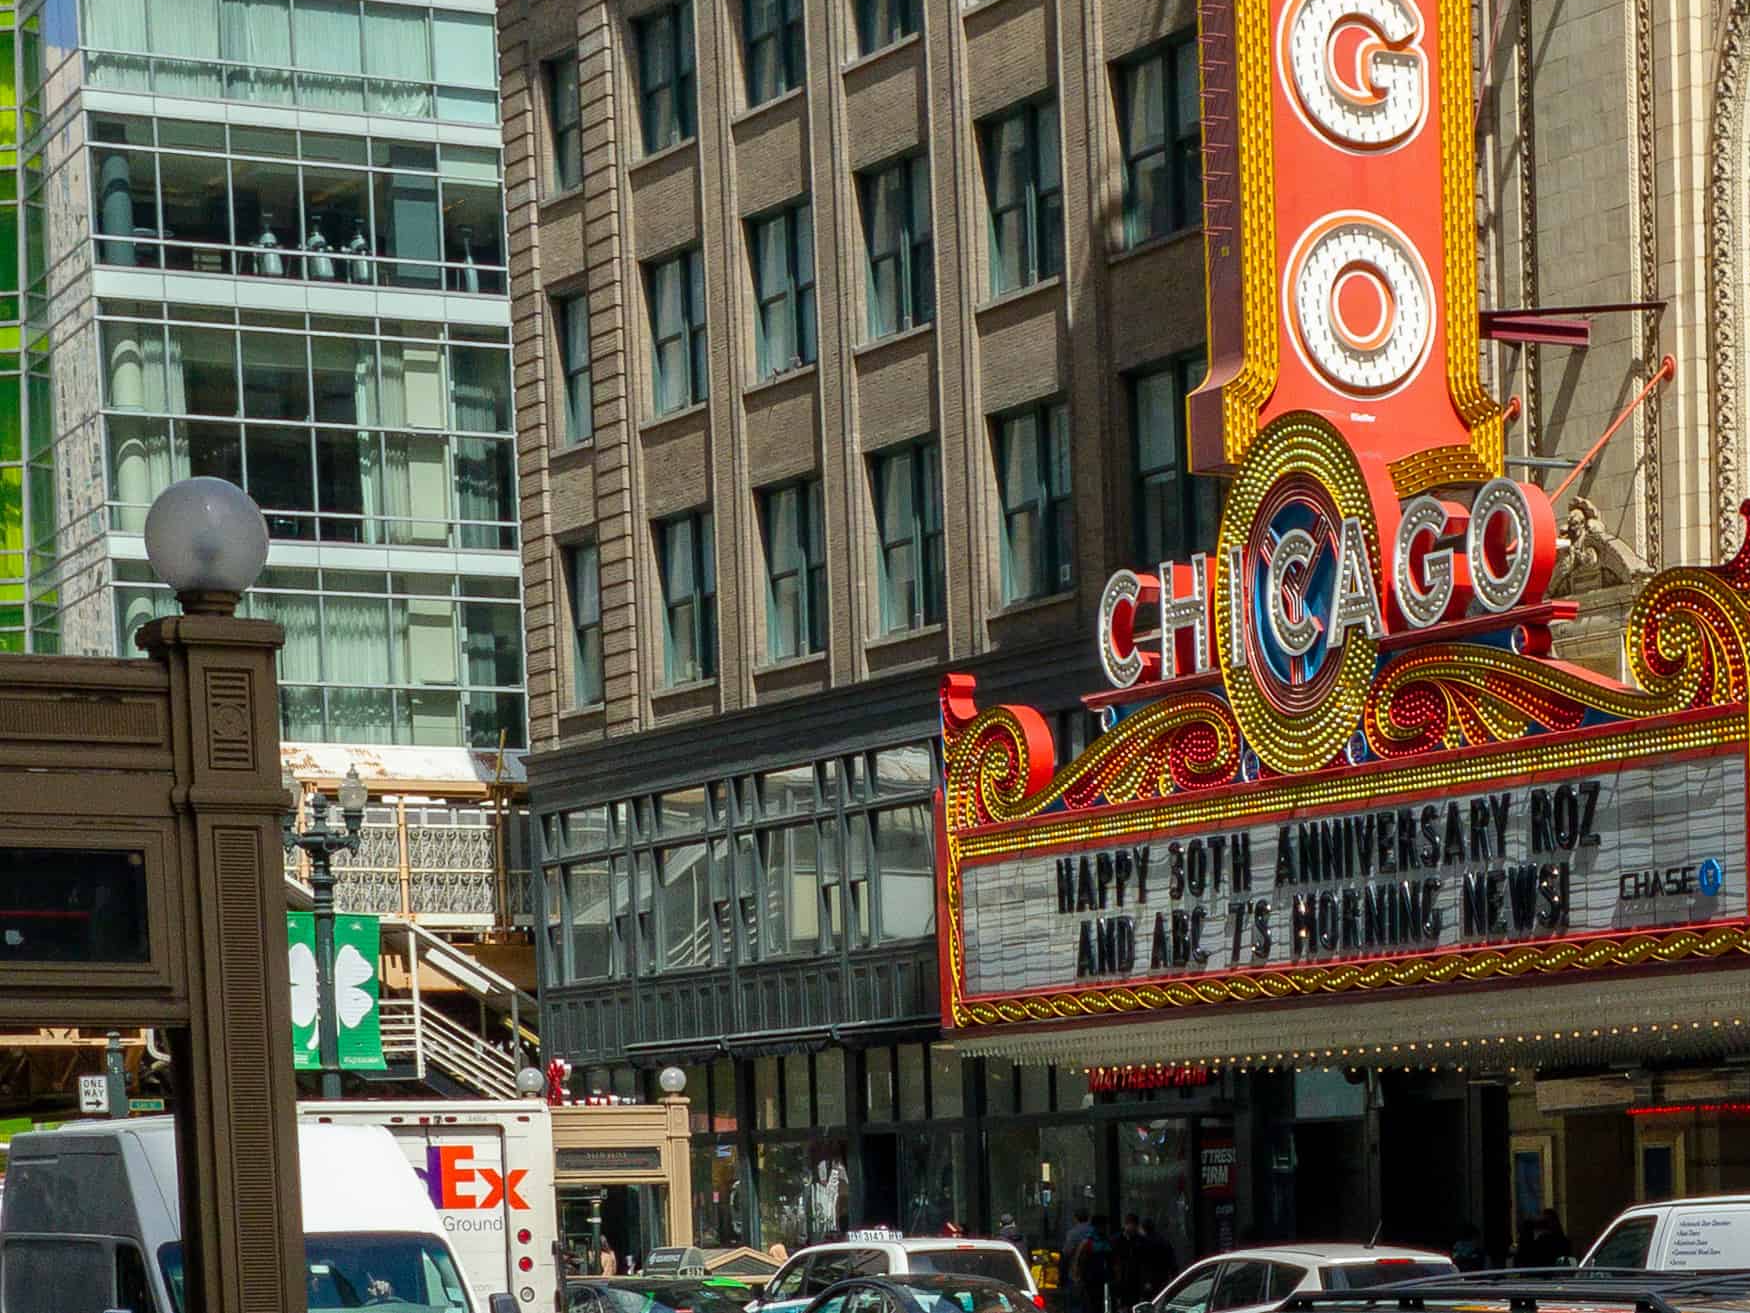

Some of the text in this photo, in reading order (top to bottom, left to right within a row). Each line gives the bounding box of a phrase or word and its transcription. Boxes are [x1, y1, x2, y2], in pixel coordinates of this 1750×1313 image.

[1099, 477, 1534, 689] CHICAGO
[1056, 845, 1150, 914] HAPPY
[1275, 792, 1511, 886] ANNIVERSARY
[1531, 780, 1600, 854] ROZ
[1620, 866, 1697, 900] CHASE
[1077, 915, 1136, 978] AND
[1151, 905, 1210, 970] ABC
[1293, 877, 1442, 956] MORNING
[1464, 862, 1570, 937] NEWS!
[83, 1079, 105, 1088] ONE
[83, 1089, 105, 1097] WAY
[442, 1215, 504, 1232] Ground
